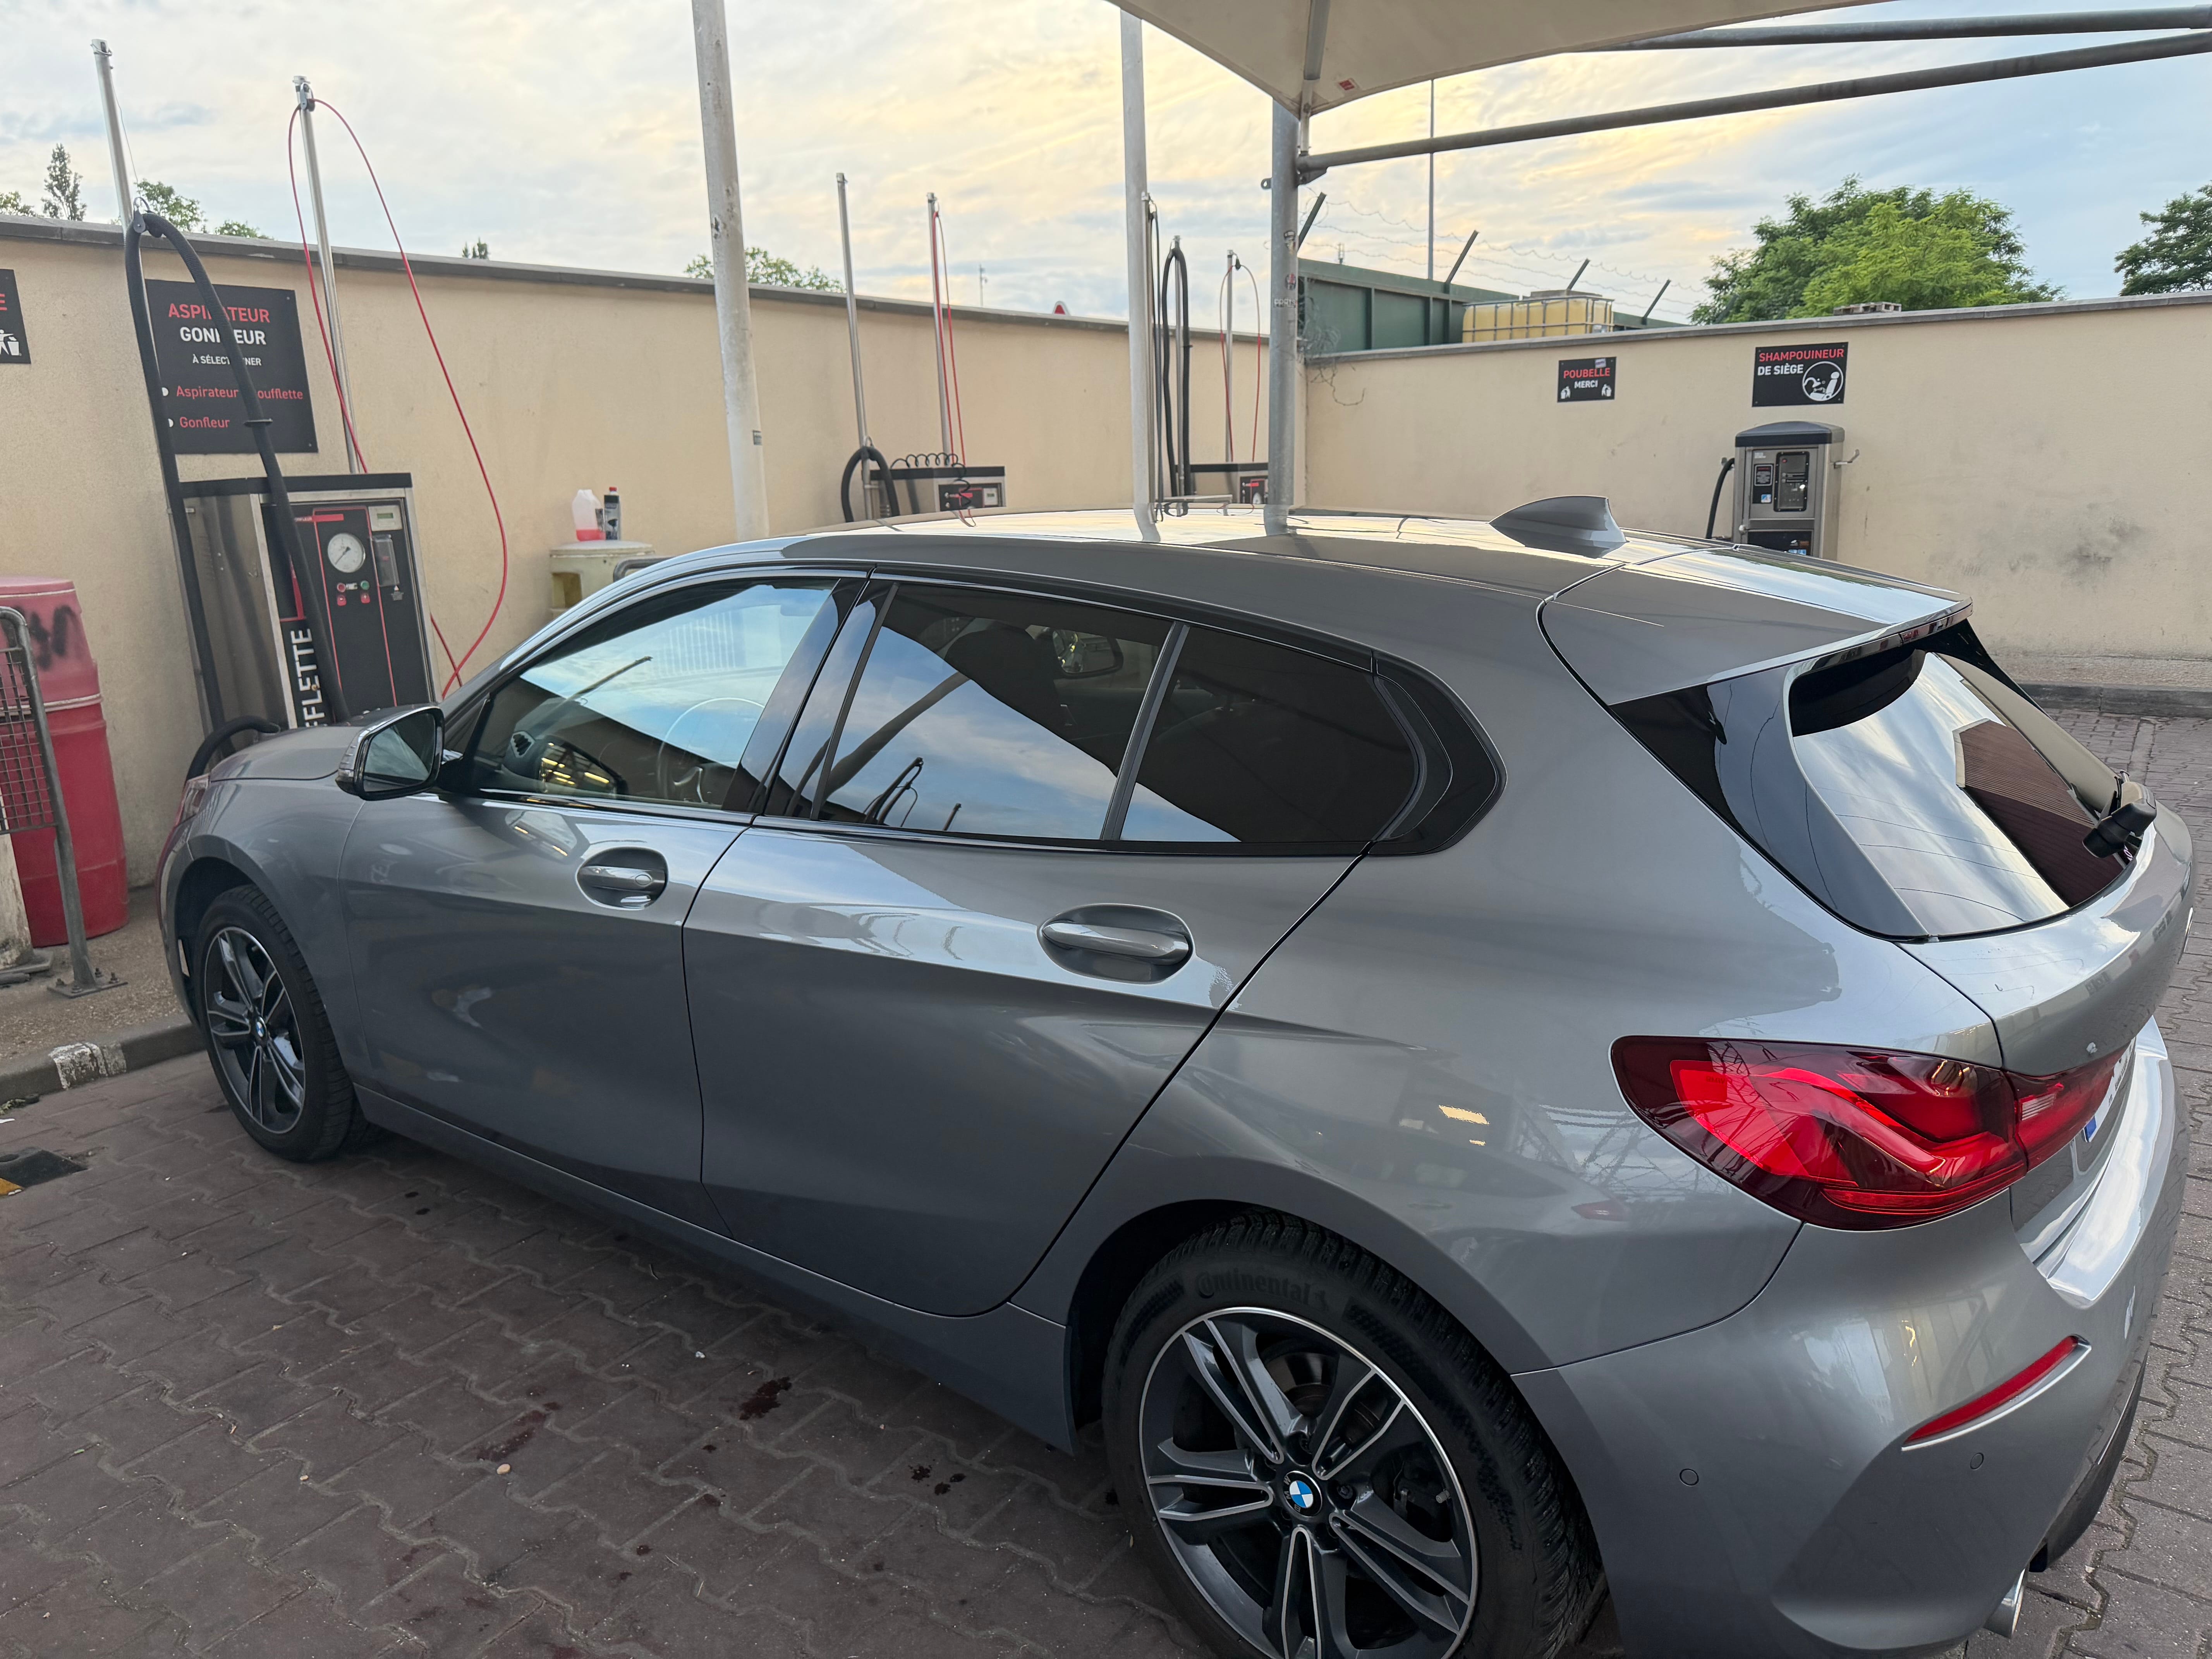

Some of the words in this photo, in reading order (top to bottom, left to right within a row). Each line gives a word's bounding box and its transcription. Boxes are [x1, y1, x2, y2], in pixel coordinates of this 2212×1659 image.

[192, 354, 199, 364] À
[1759, 349, 1844, 362] SHAMPOUINEUR
[1563, 368, 1610, 379] POUBELLE
[1757, 366, 1772, 376] DE
[1774, 362, 1803, 375] SIÈGE
[1574, 380, 1599, 389] MERCI
[176, 385, 239, 399] Aspirateur
[257, 388, 303, 400] oufflette
[179, 416, 230, 428] Gonfleur
[290, 628, 328, 728] FLETTE
[1195, 1267, 1312, 1305] Continental
[1283, 1475, 1301, 1513] BMW
